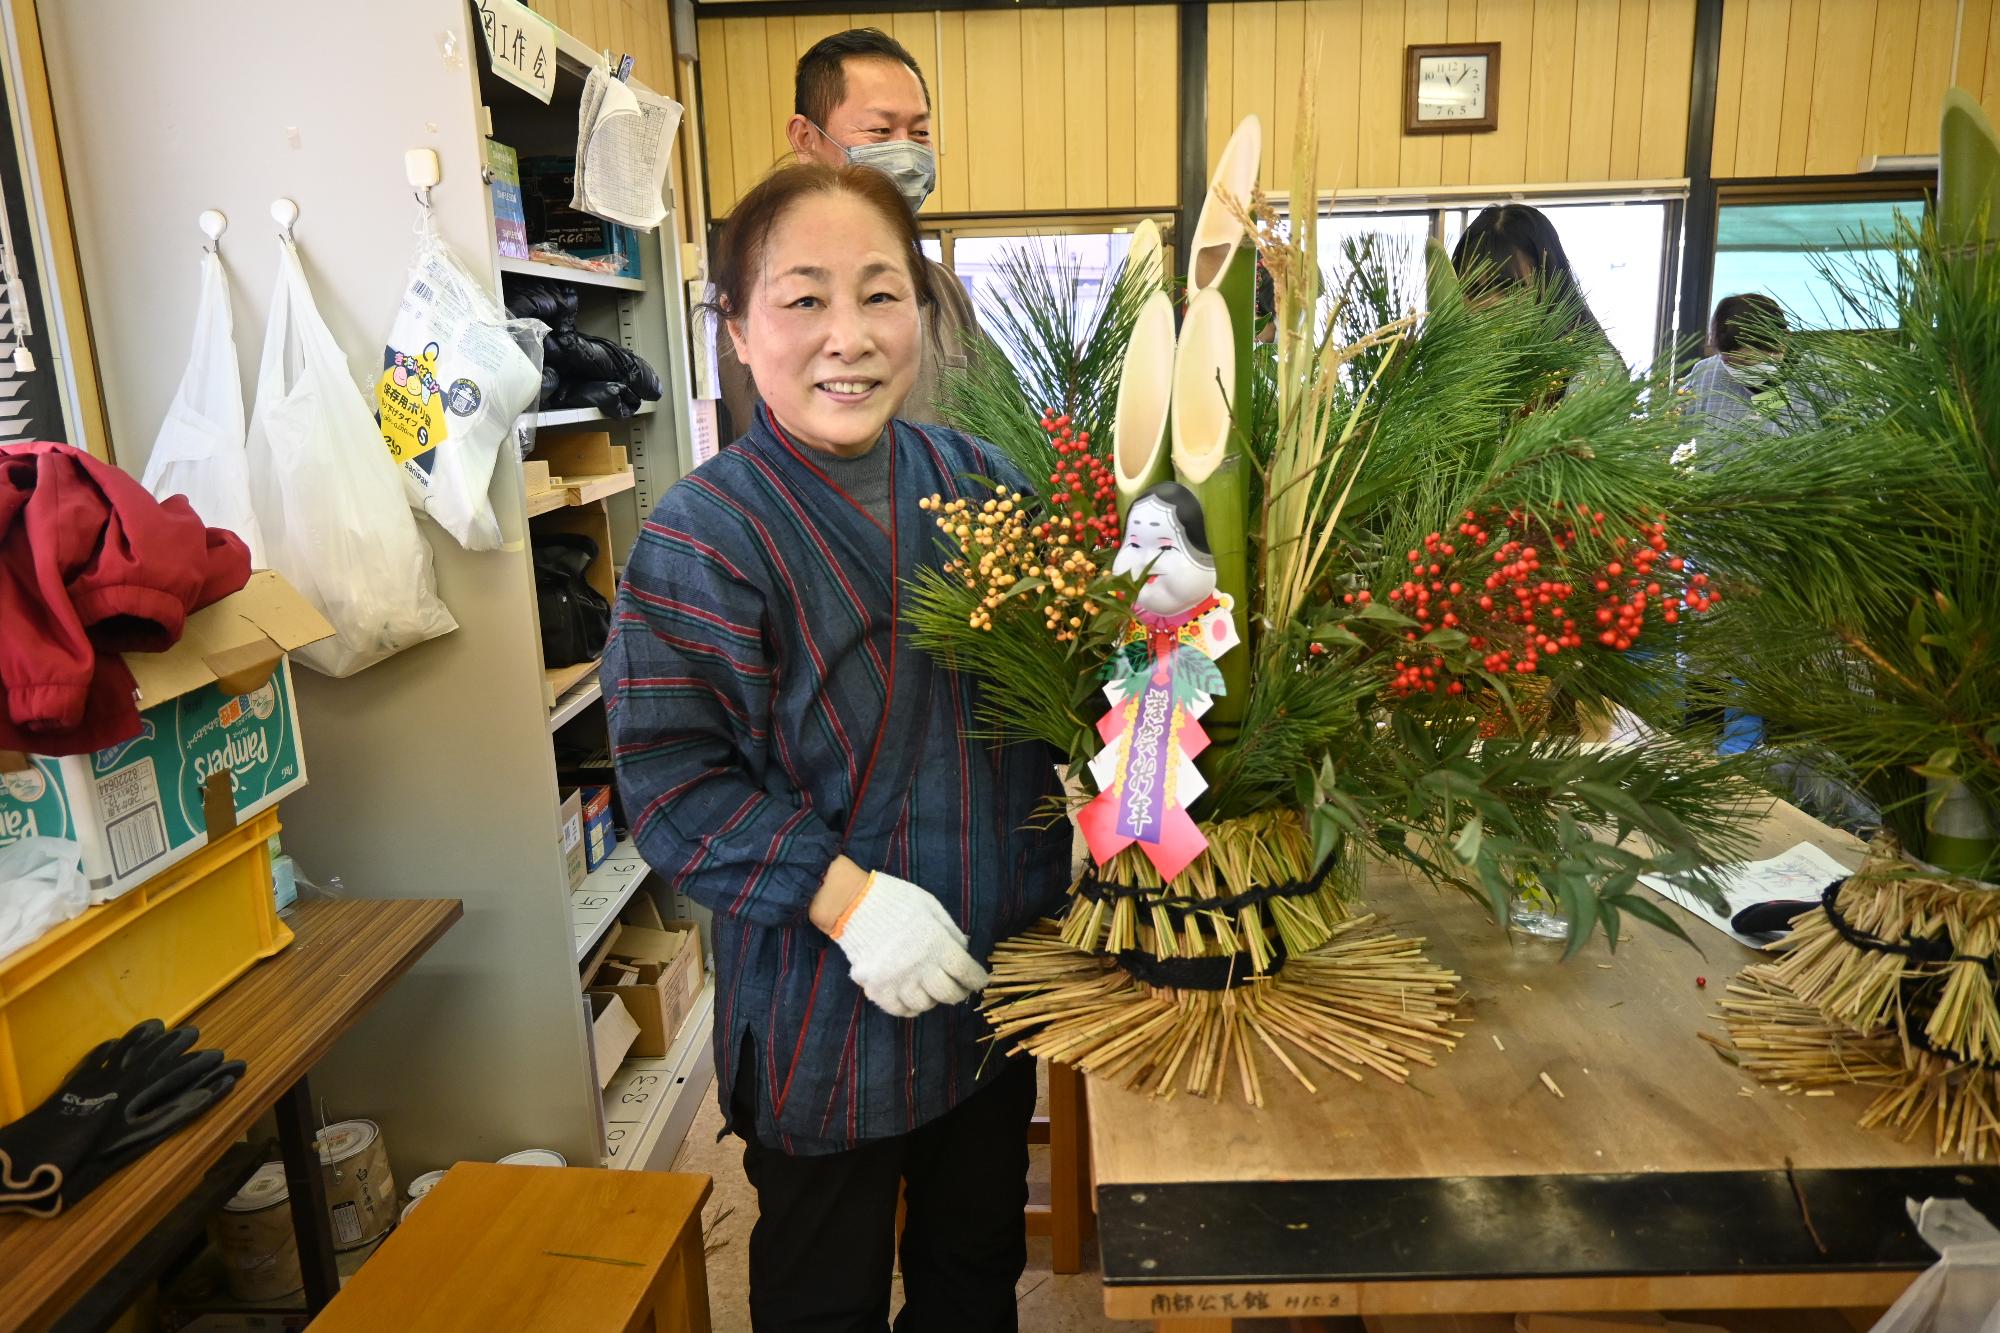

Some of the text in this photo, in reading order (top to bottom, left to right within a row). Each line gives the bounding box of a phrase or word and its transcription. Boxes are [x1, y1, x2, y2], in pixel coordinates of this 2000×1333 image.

[1437, 63, 1445, 73] 11
[1448, 61, 1458, 72] 12
[1424, 71, 1435, 81] 10
[1472, 68, 1479, 79] 2
[1436, 105, 1443, 116] 7
[1447, 106, 1454, 116] 6
[1459, 105, 1466, 116] 5
[194, 726, 269, 785] Pampers
[1127, 688, 1169, 837] 謹賀新年
[281, 763, 293, 780] P&G
[0, 807, 39, 839] Pa
[1151, 1290, 1270, 1314] 南部公民館
